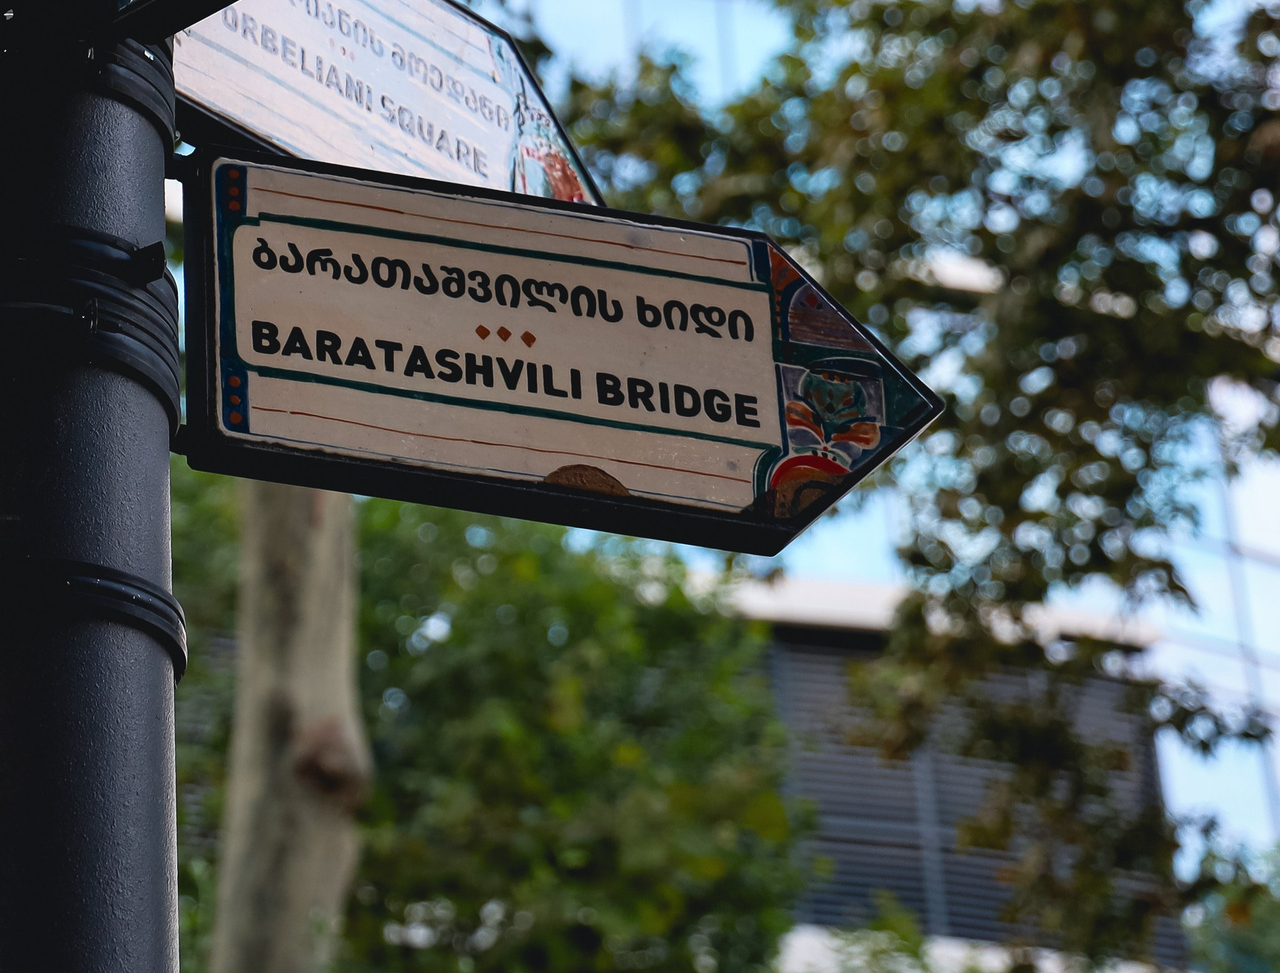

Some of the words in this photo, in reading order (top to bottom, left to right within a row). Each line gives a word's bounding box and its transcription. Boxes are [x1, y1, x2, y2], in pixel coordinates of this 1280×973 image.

[221, 5, 374, 114] ORBELIANI
[380, 93, 489, 178] SQUARE
[391, 45, 510, 132] მოედანი
[251, 237, 623, 322] ბარათაშვილის
[635, 295, 755, 342] ხიდი
[251, 320, 582, 401] BARATASHVILI
[595, 372, 761, 428] BRIDGE
